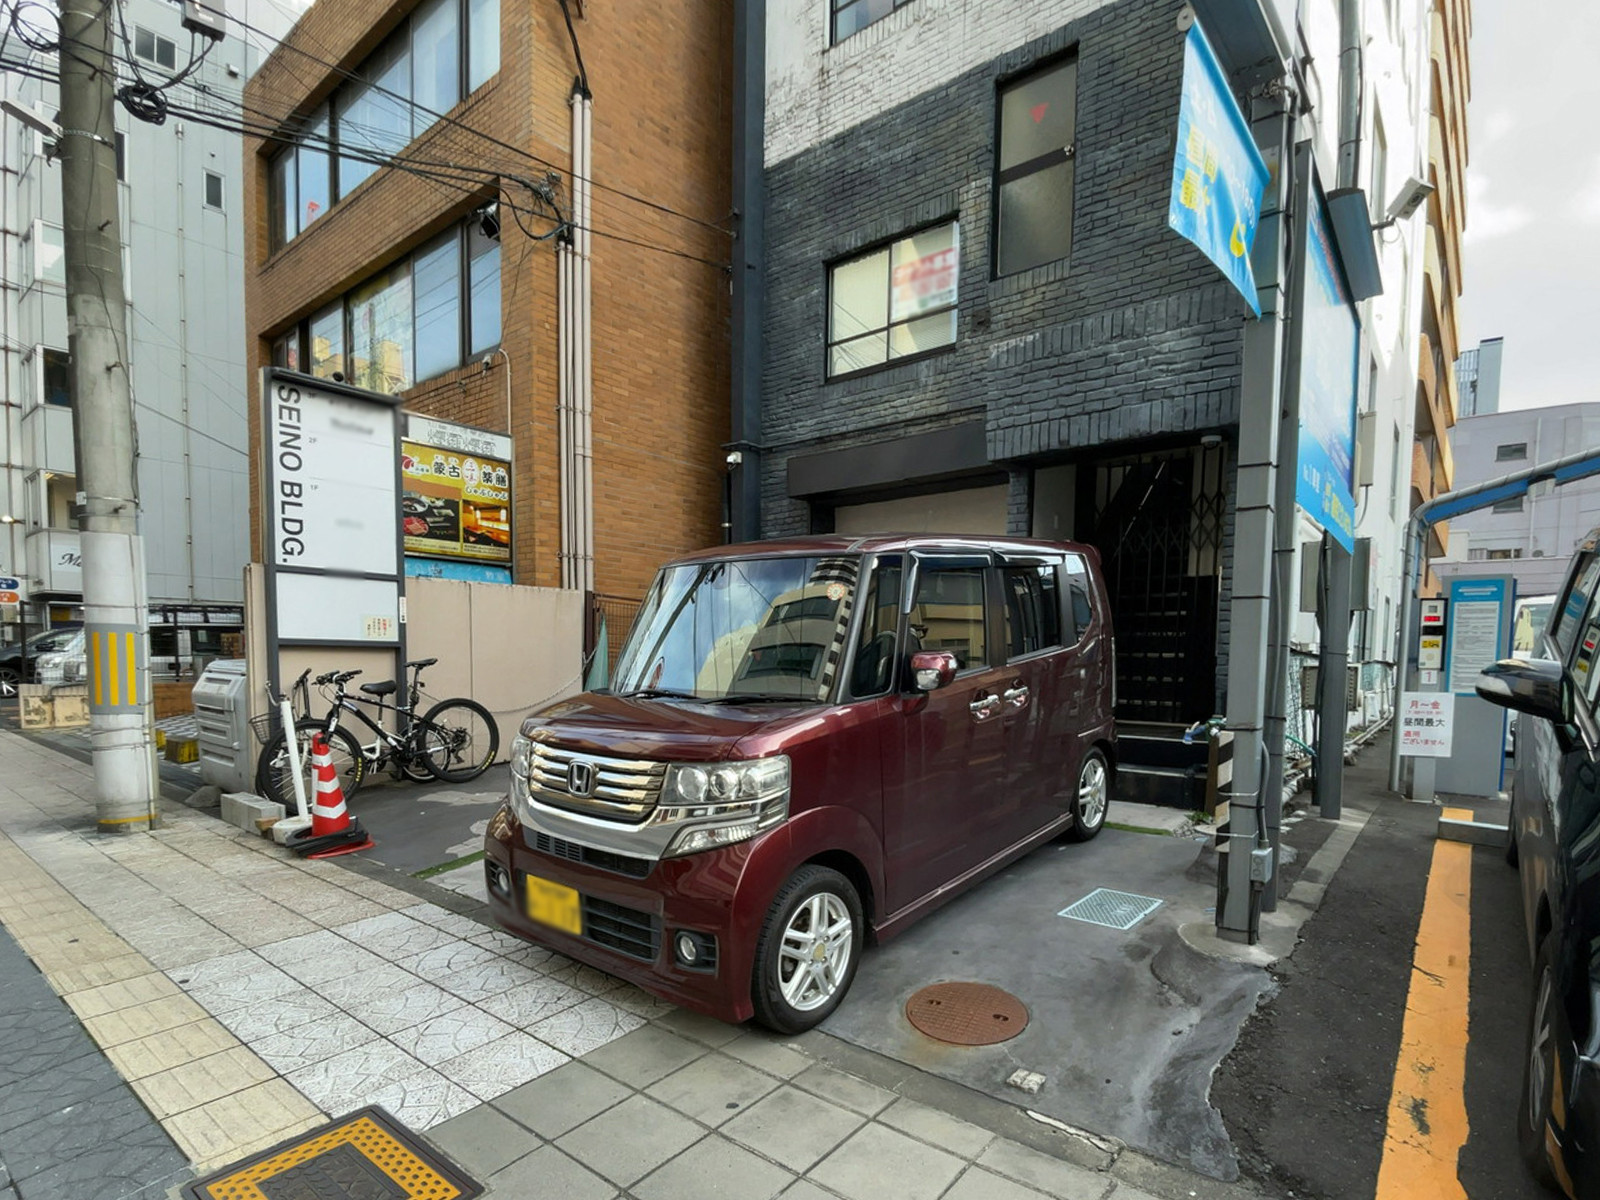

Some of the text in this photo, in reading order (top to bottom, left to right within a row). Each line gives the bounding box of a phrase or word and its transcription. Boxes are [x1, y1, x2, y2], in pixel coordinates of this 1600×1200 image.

[277, 384, 305, 563] SEINO BLDG.
[1404, 717, 1446, 728] 昼間最大
